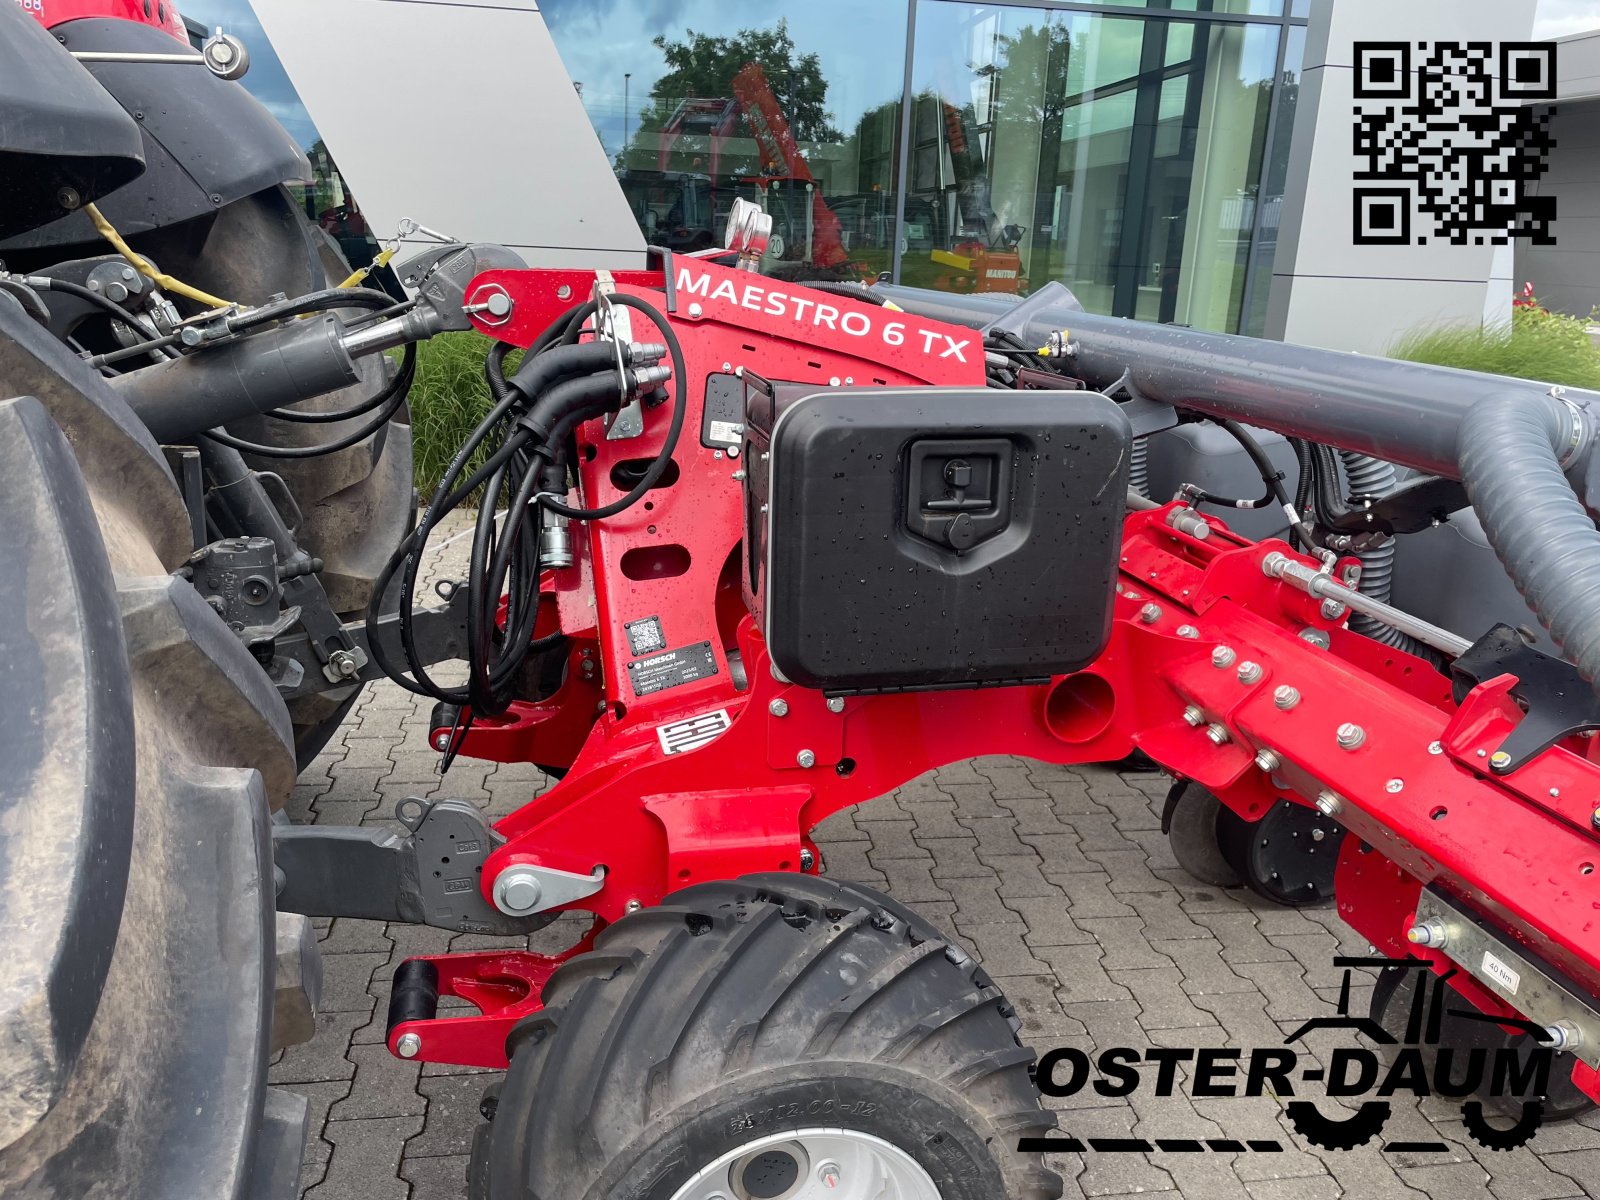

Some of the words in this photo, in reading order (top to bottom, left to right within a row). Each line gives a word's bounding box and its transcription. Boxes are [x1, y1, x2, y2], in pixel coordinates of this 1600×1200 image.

[771, 239, 781, 253] 20
[676, 268, 871, 336] MAESTRO
[882, 323, 905, 346] 6
[917, 329, 970, 363] TX
[643, 652, 676, 668] HORSCH
[1489, 963, 1499, 973] 40
[1499, 969, 1512, 983] Nm
